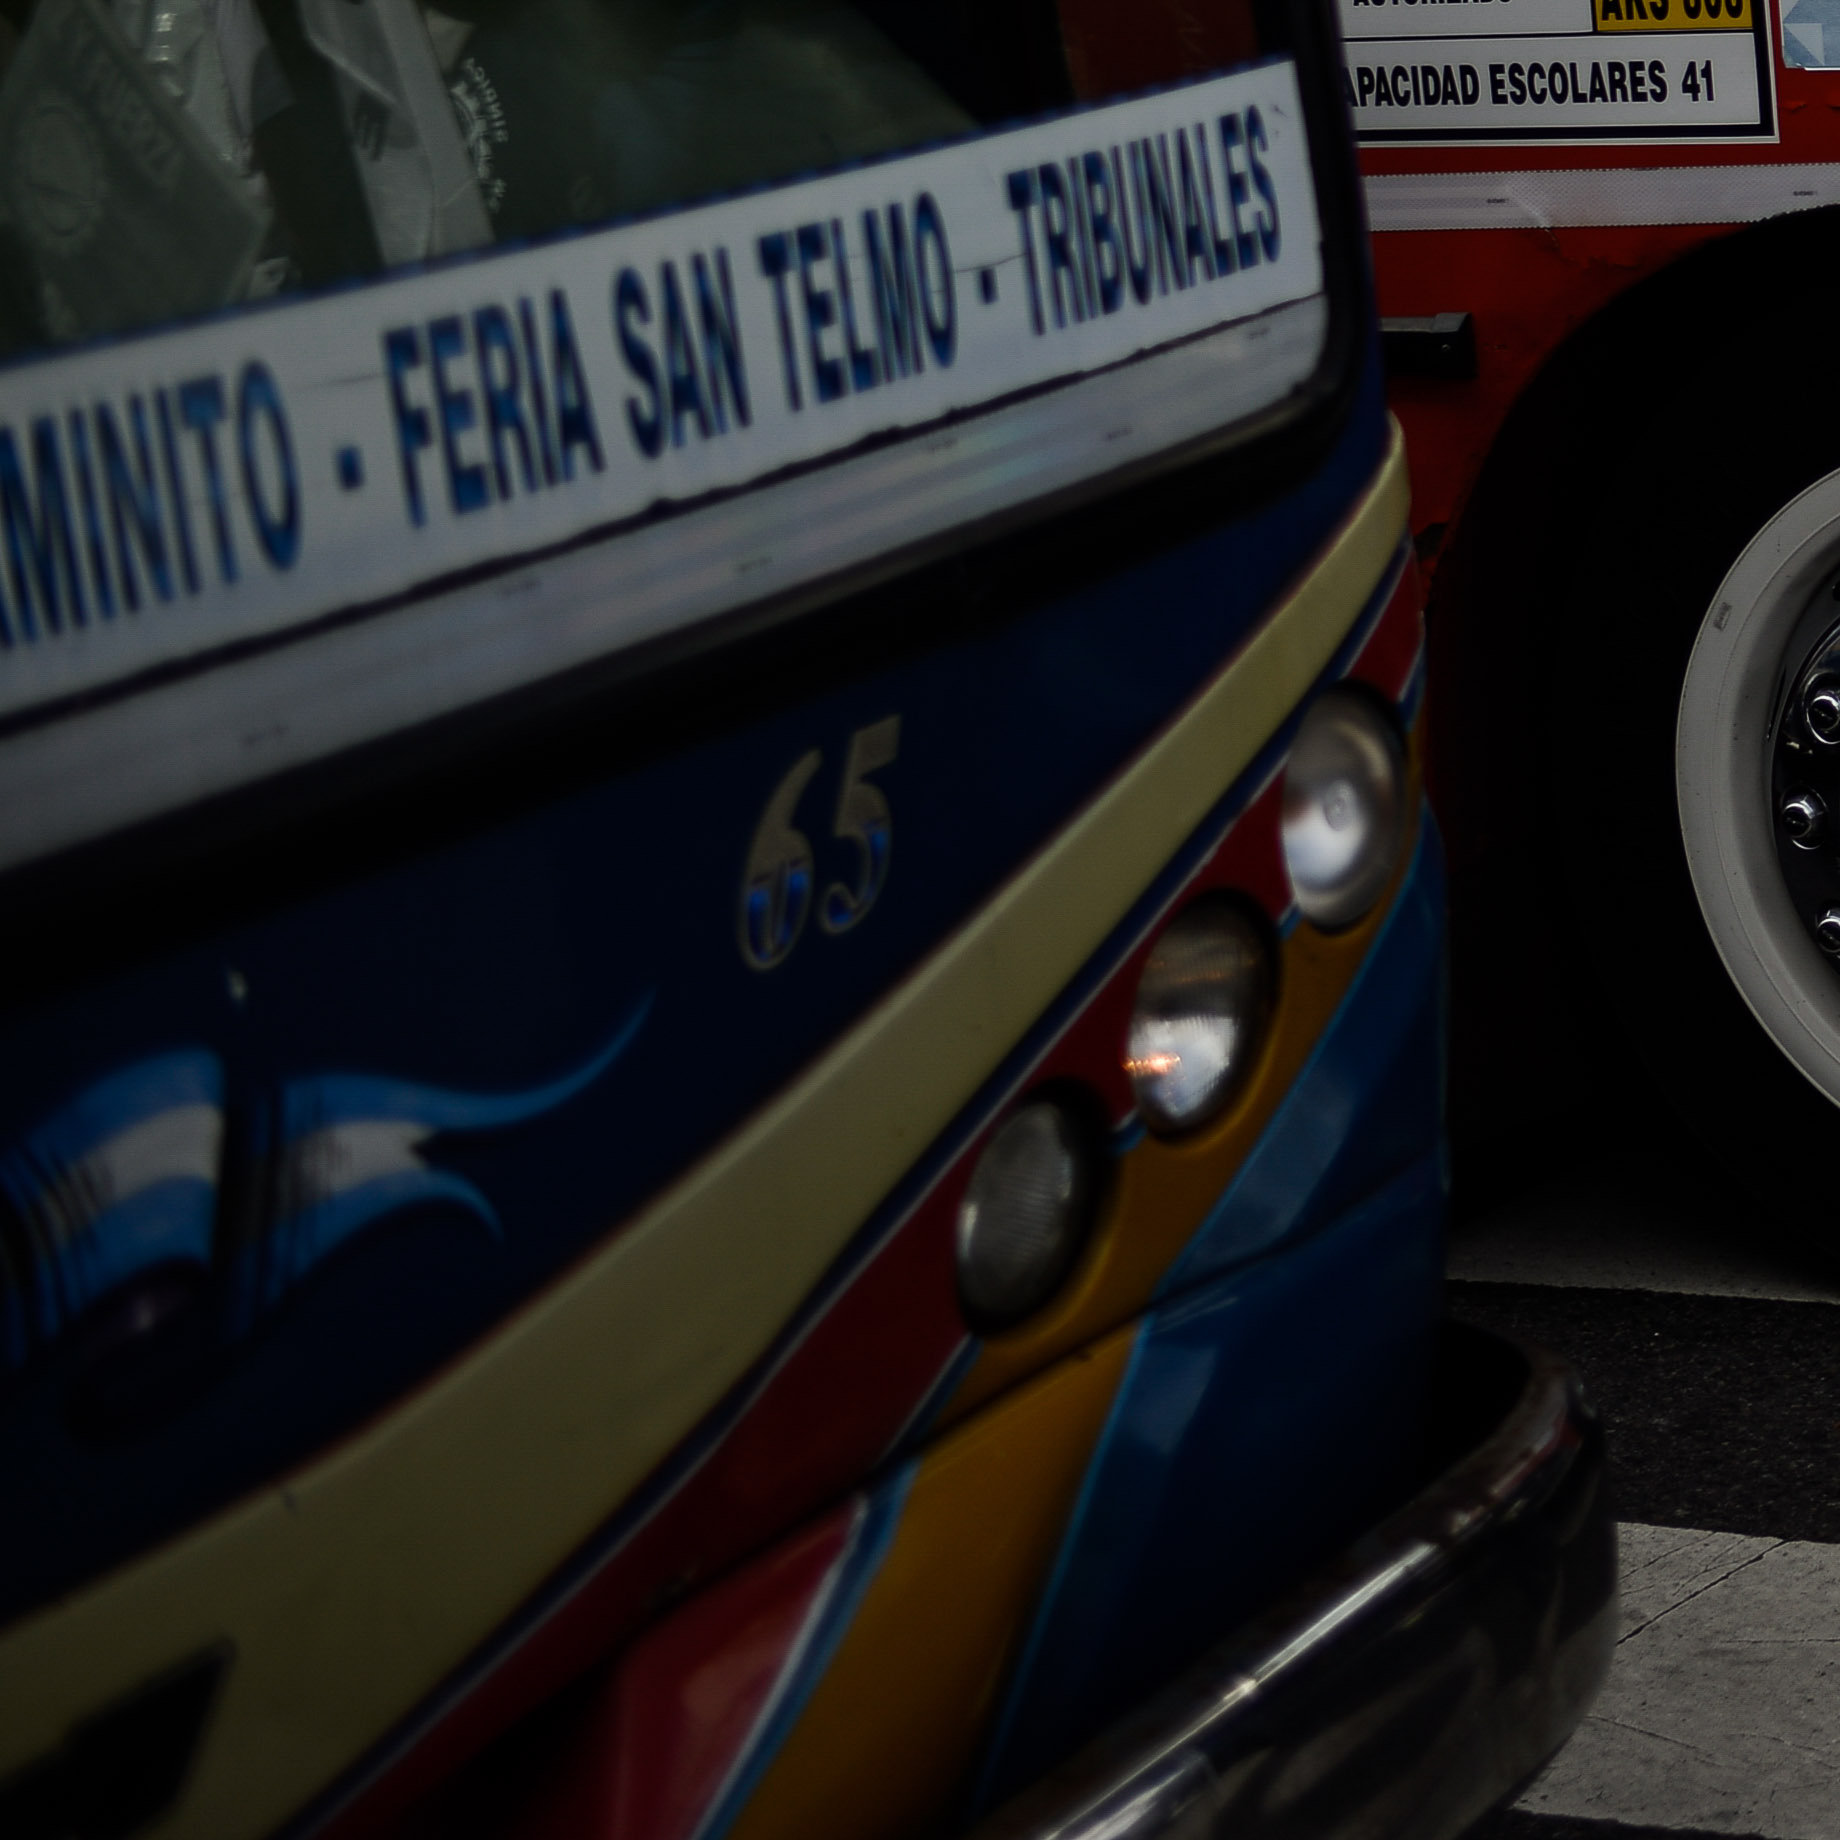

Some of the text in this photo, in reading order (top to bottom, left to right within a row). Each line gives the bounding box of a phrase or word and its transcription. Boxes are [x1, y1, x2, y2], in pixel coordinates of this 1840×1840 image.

[1489, 61, 1669, 105] ESCOLARES
[1681, 60, 1715, 103] 41
[382, 291, 608, 526] FERIA
[614, 249, 752, 458] SAN
[757, 192, 957, 404] TELMO
[1008, 105, 1280, 334] TRIBUNALES
[735, 713, 901, 972] 65
